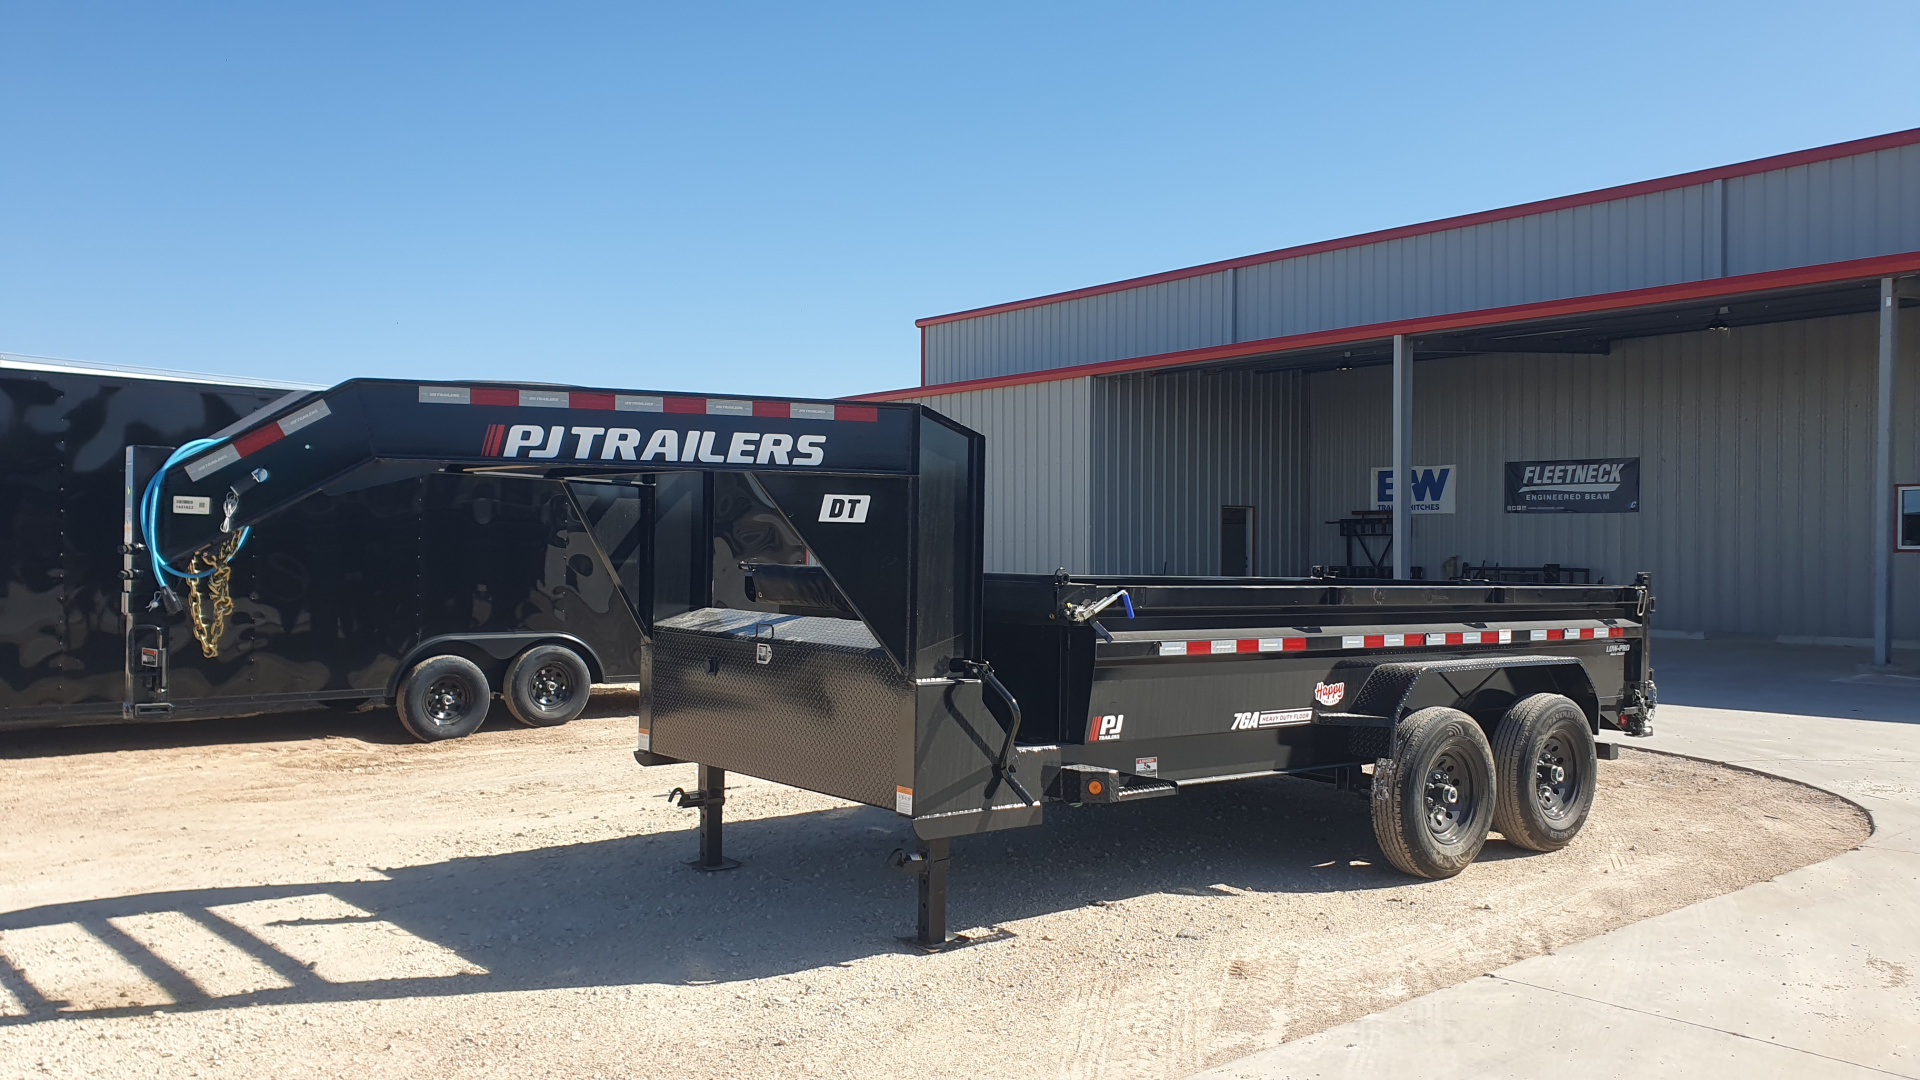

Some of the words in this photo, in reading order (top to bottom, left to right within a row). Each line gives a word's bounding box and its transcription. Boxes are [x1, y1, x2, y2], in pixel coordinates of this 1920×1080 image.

[502, 424, 565, 459] PJ
[571, 426, 827, 466] TRAILERS
[1522, 463, 1624, 484] FLEETNECK
[1526, 493, 1582, 501] ENGINEERED
[828, 498, 861, 519] DT
[1315, 682, 1344, 700] Happy
[1099, 714, 1124, 735] PJ
[1230, 711, 1260, 731] 7GA
